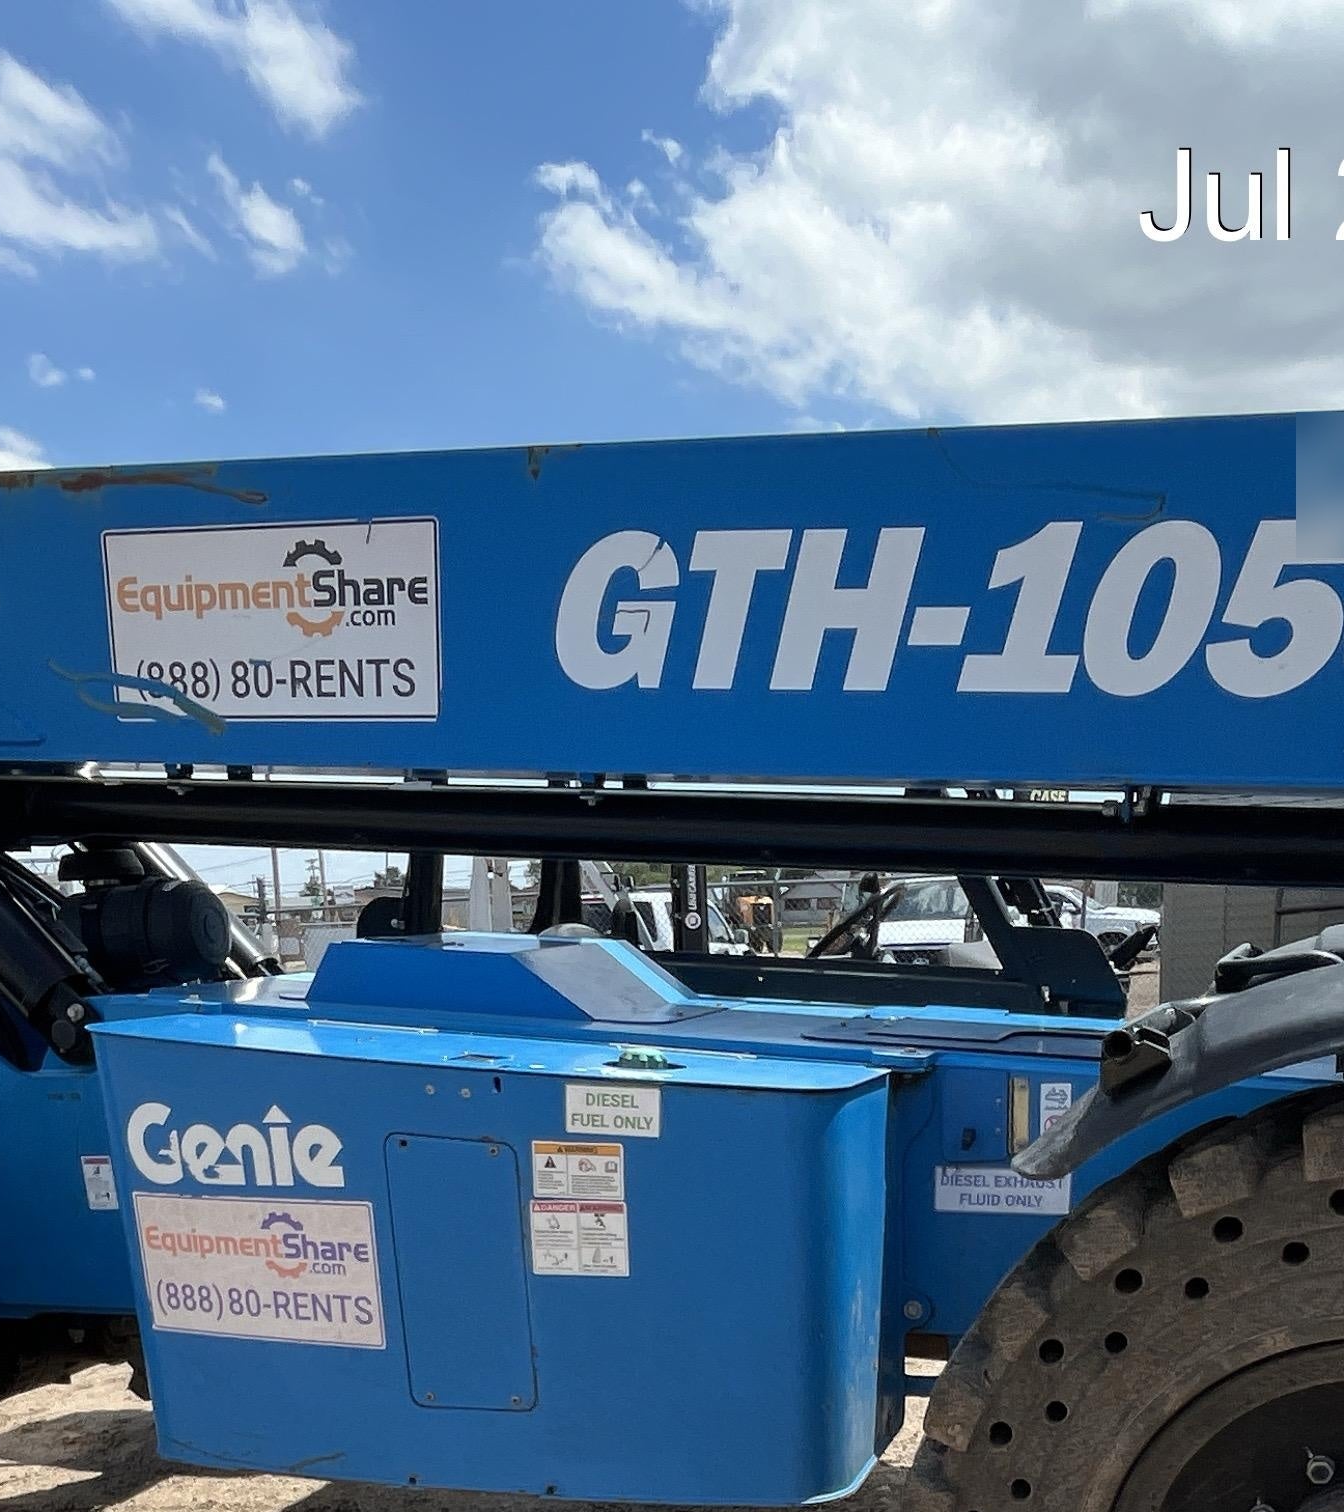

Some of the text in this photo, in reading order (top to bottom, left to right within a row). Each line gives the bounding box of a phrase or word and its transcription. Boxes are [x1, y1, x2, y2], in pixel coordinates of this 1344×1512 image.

[117, 569, 428, 620] EquipmentShare
[345, 609, 395, 627] .com
[137, 657, 416, 702] (888) 80-RENTS
[585, 1092, 639, 1109] DIESEL
[570, 1113, 654, 1130] FUEL ONLY
[127, 1102, 344, 1187] Genie
[940, 1174, 1064, 1190] DIESEL EXHAUST
[540, 1203, 575, 1212] DANGER
[959, 1192, 1043, 1208] FLUID ONLY
[145, 1226, 370, 1263] EquipmentShare
[308, 1261, 347, 1277] .com
[156, 1279, 374, 1325] (888) 80-RENTS
